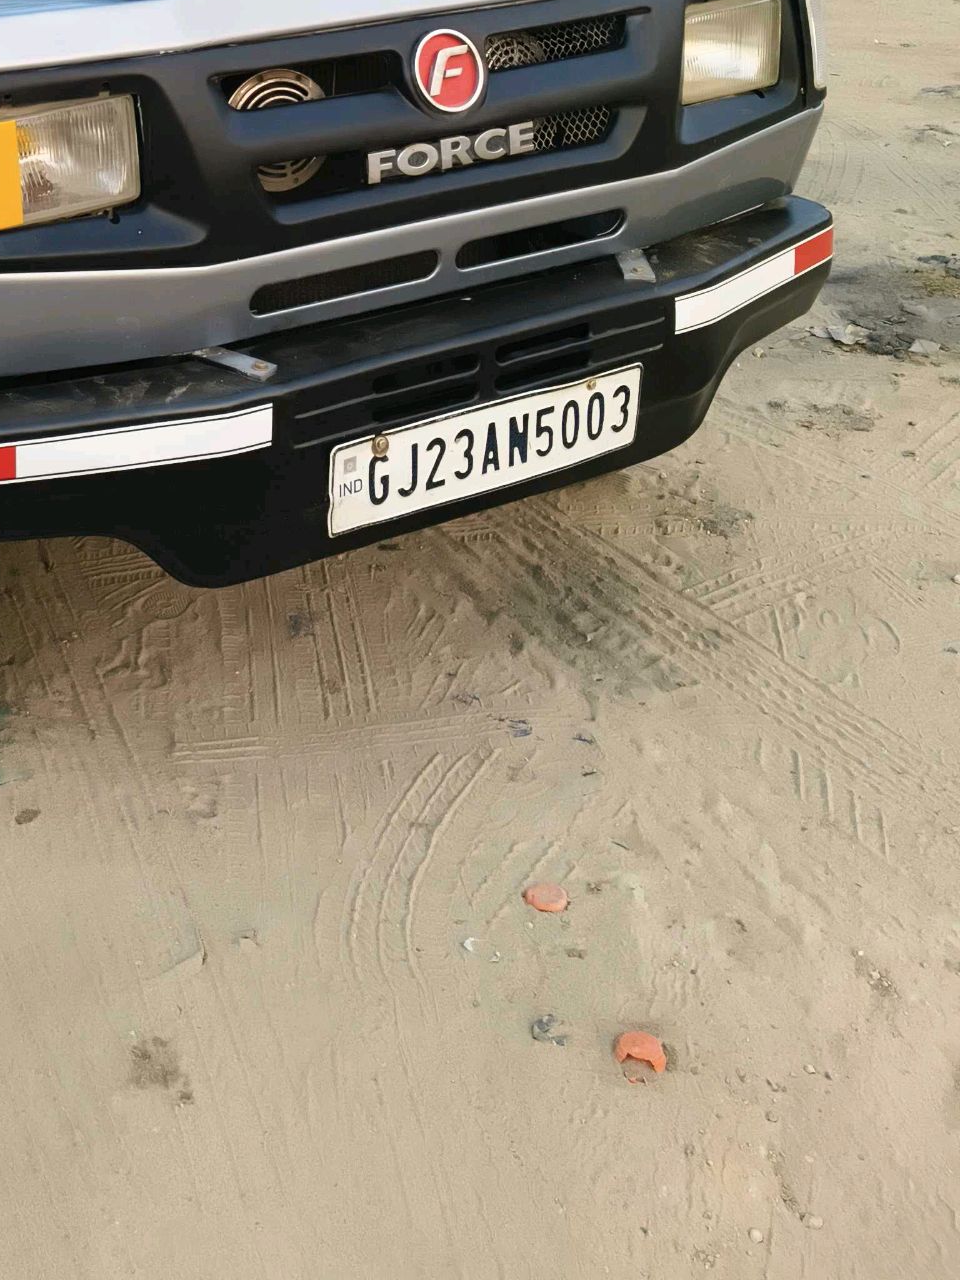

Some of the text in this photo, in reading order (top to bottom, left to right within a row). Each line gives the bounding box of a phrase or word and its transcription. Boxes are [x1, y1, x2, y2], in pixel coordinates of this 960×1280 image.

[367, 120, 535, 185] FORCE
[368, 384, 631, 506] GJ23AN5003
[339, 478, 363, 498] IND
